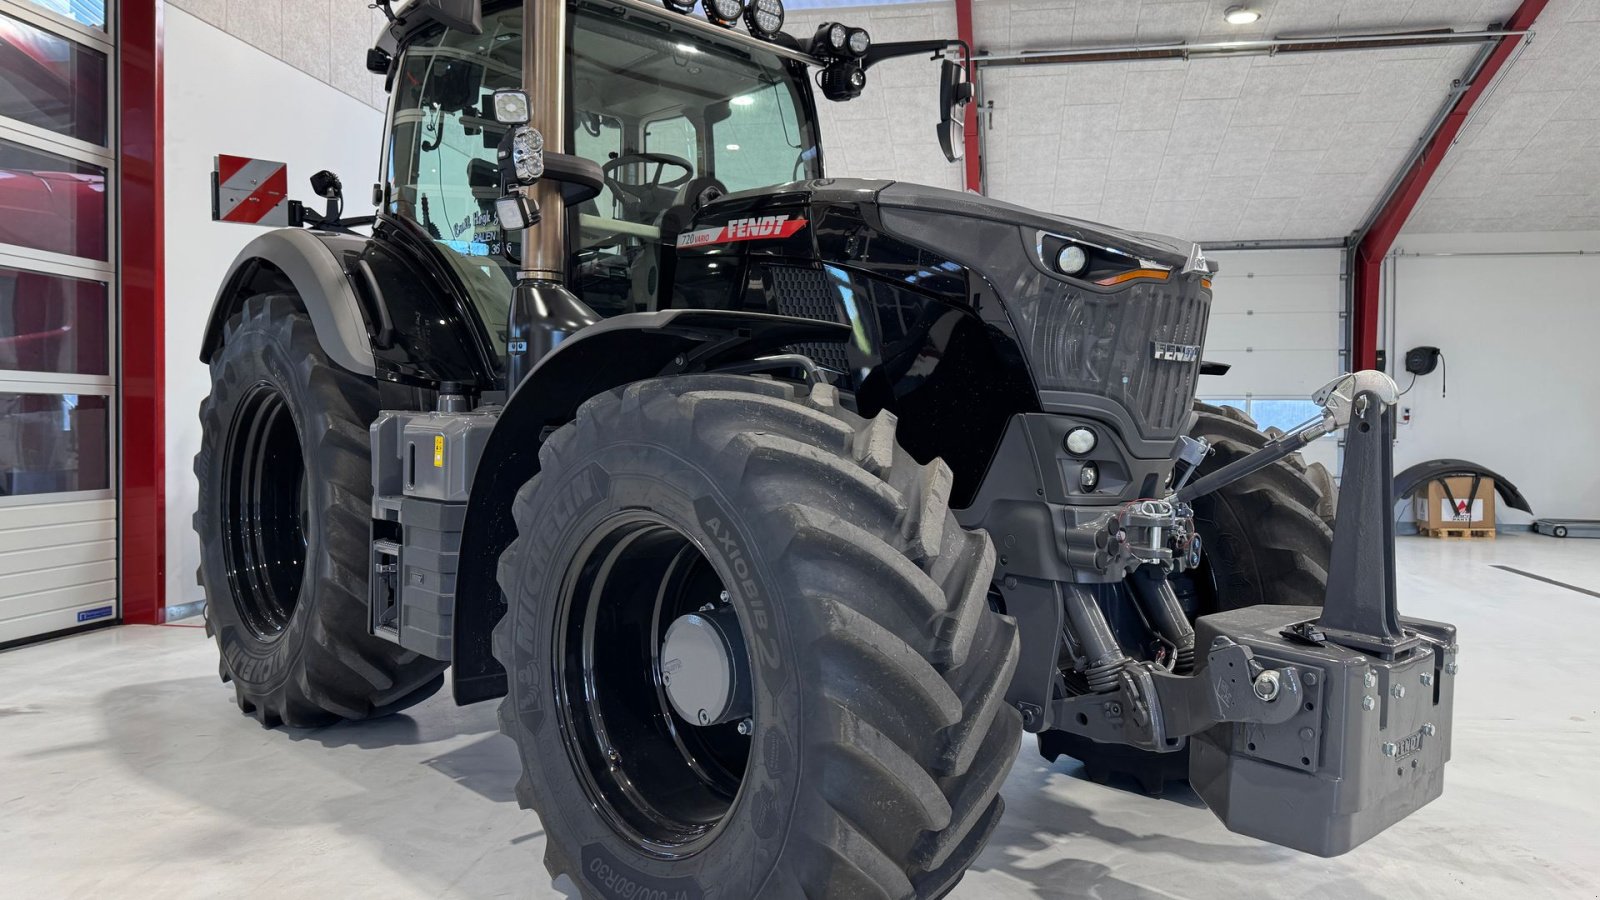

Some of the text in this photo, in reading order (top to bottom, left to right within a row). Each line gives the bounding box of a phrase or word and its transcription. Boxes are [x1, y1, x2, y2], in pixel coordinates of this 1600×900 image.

[727, 214, 790, 239] FENDT
[682, 233, 695, 246] 720
[1154, 341, 1201, 362] FENDT
[516, 466, 594, 655] MICHELIN
[705, 516, 781, 670] AXIOBIB 2
